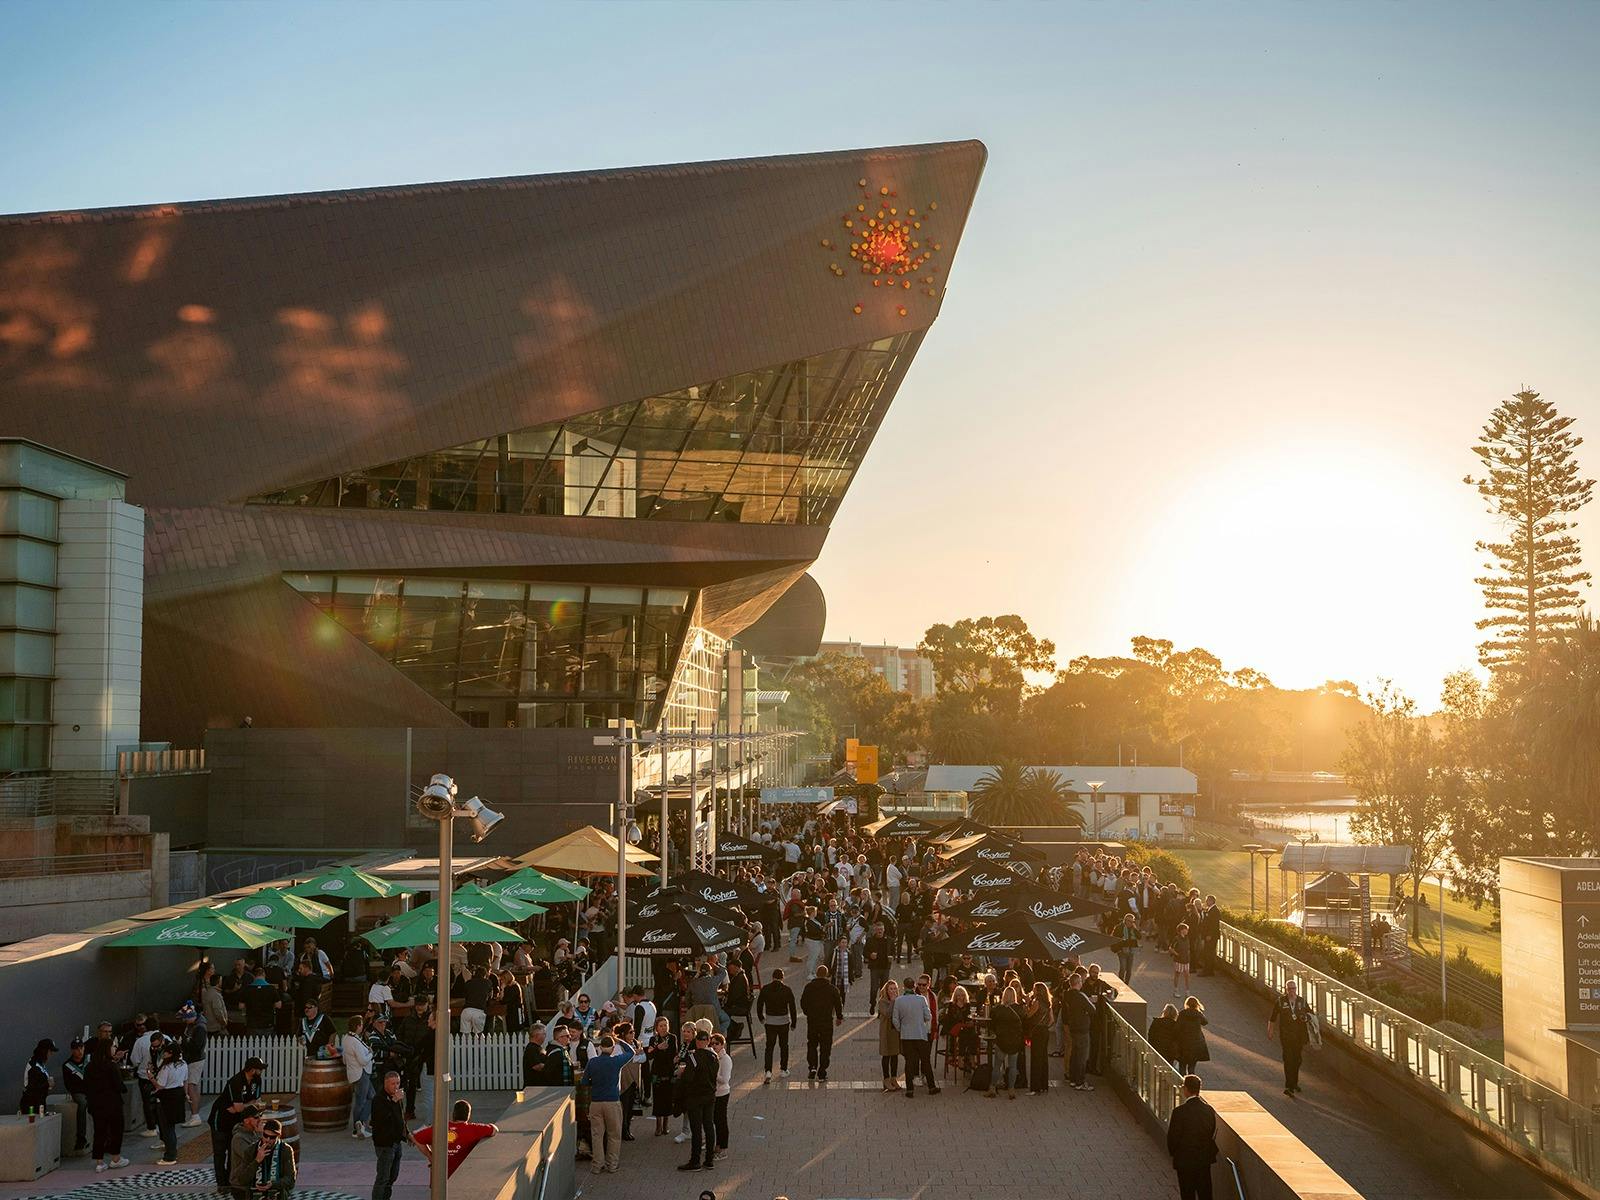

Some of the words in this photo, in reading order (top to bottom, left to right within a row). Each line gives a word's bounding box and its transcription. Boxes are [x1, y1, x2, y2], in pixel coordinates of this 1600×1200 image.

[567, 755, 617, 764] RIVERBAN
[976, 848, 1011, 859] Coopers
[970, 873, 1012, 886] Coopers
[500, 883, 547, 898] Coopers
[699, 886, 738, 903] Coopers
[1029, 901, 1074, 919] Coopers
[155, 924, 217, 941] Coopers
[967, 932, 1025, 951] Coopers
[636, 947, 652, 955] MADE
[673, 947, 692, 955] OWNED
